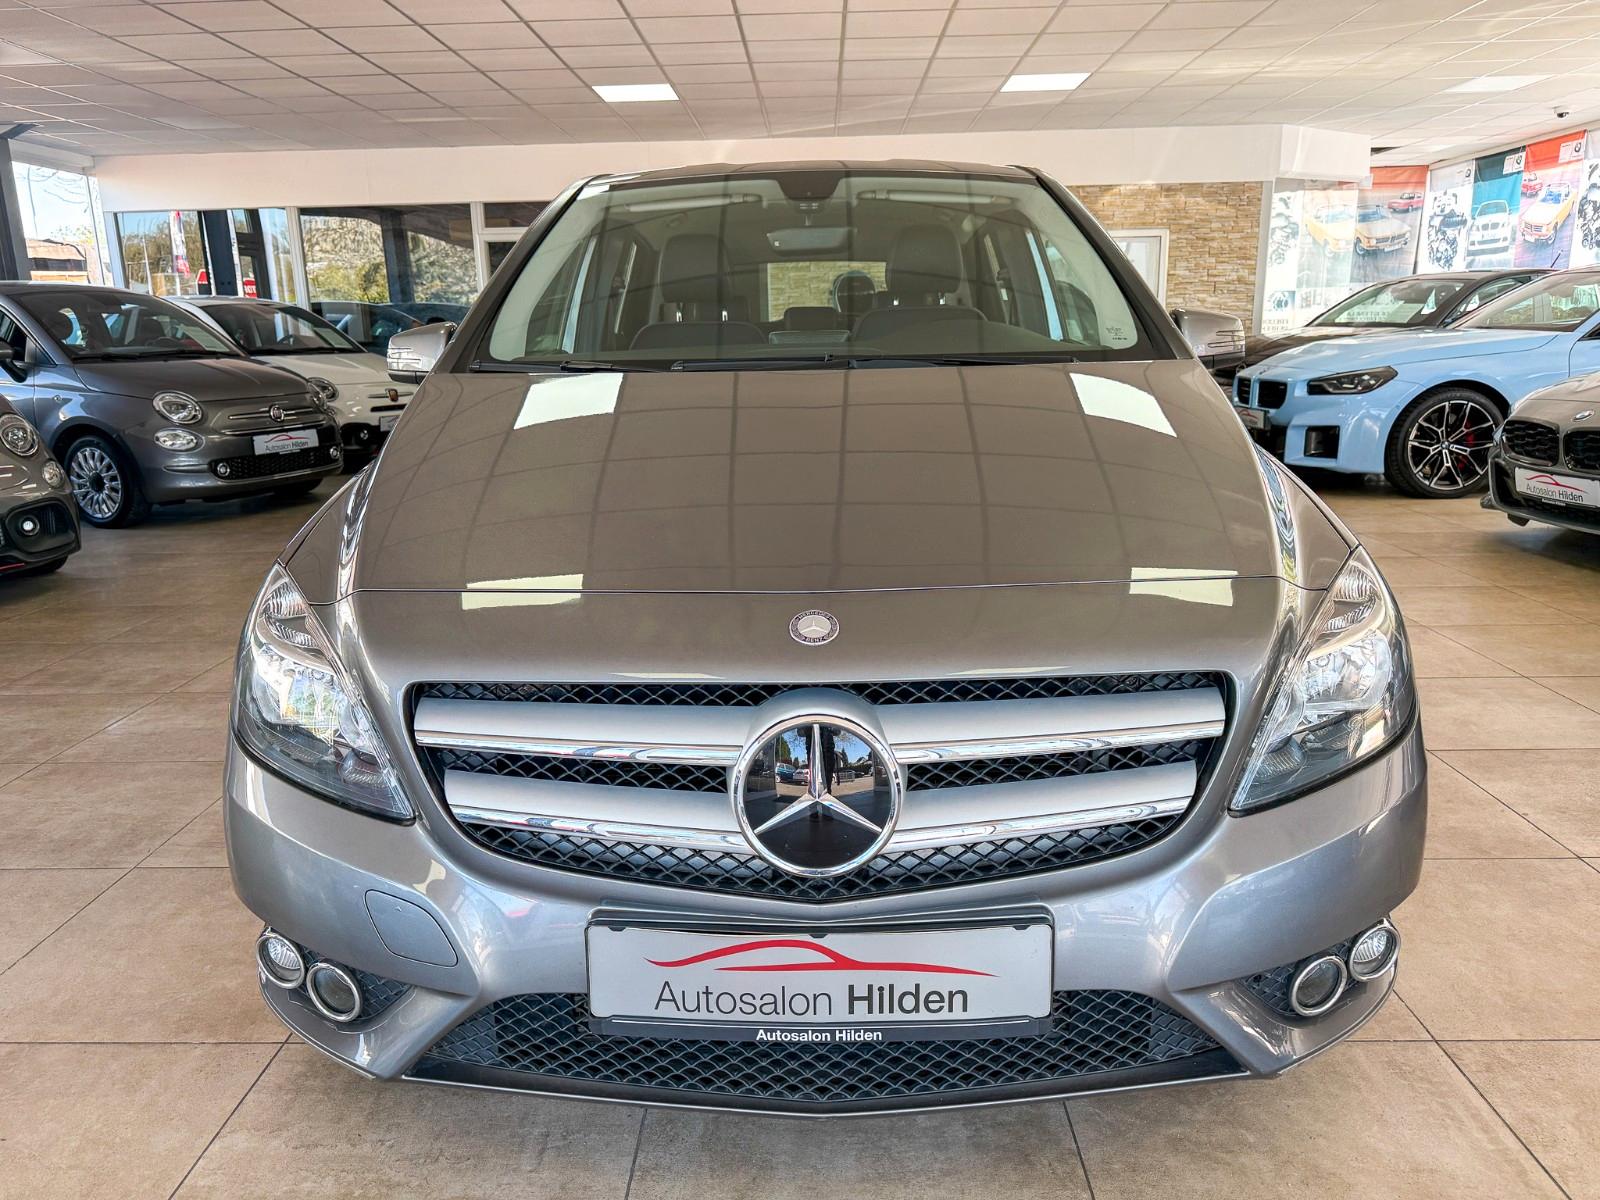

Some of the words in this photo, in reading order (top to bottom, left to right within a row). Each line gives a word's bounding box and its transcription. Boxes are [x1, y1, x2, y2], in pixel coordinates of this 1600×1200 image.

[1526, 483, 1556, 498] Autosalon
[1558, 489, 1584, 502] Hilden
[654, 980, 832, 1017] Autosalon
[847, 983, 968, 1015] Hilden
[756, 1028, 831, 1042] Autosalon
[835, 1028, 883, 1042] Hilden
